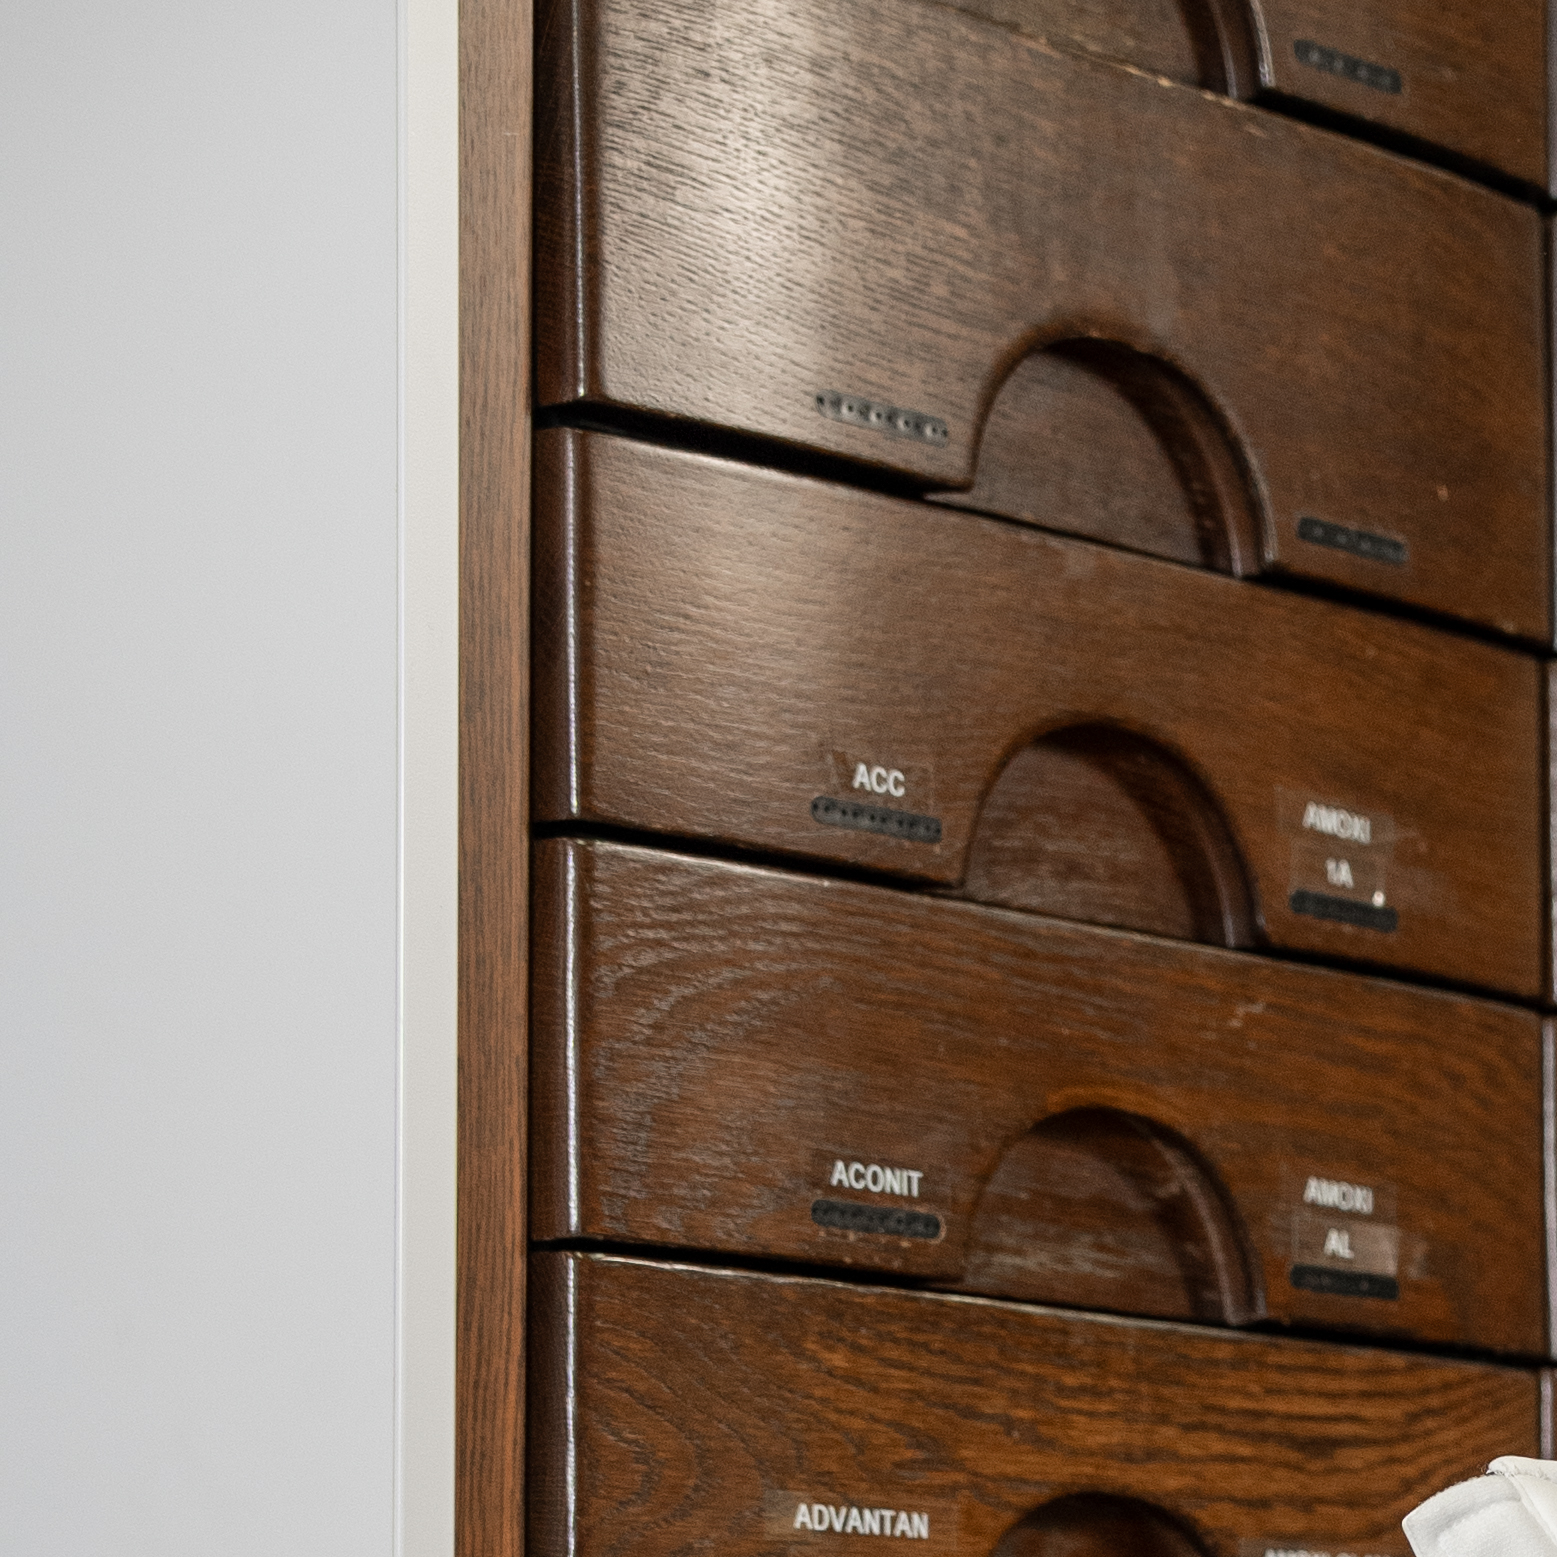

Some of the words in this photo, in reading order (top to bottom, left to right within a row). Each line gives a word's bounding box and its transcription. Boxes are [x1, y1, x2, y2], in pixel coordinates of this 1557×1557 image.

[853, 762, 905, 797] ACC
[834, 1161, 924, 1198] ACONIT
[1324, 1230, 1354, 1259] AL
[792, 1502, 929, 1539] ADVANTAN
